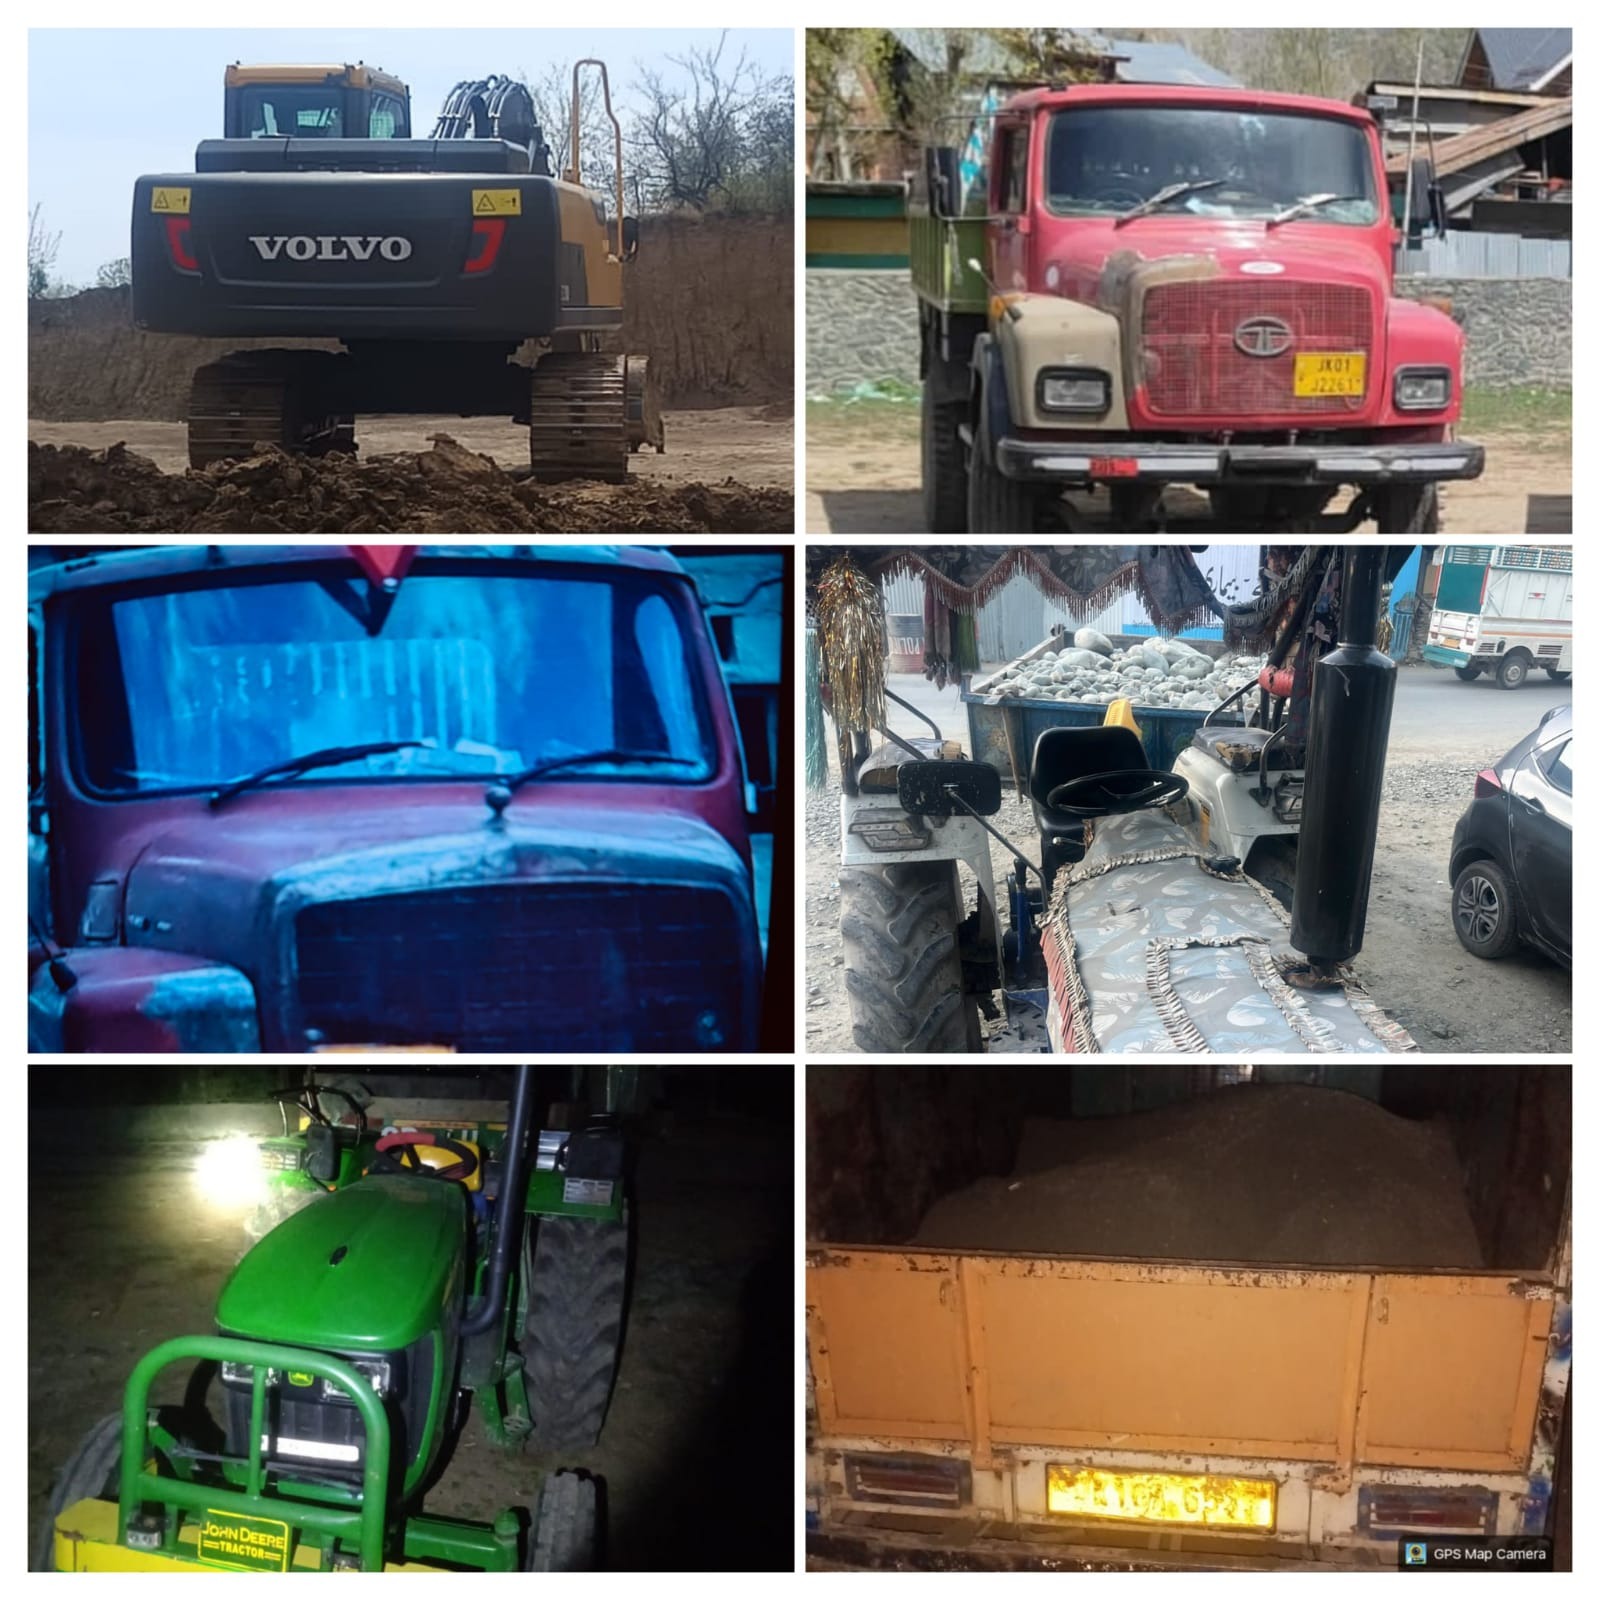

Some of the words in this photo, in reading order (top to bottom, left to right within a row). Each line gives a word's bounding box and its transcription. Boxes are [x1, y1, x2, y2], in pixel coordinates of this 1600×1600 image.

[250, 236, 412, 260] VOLVO
[1317, 358, 1350, 372] JK01
[202, 1521, 238, 1540] JOHN
[240, 1527, 285, 1549] DEERE
[219, 1541, 265, 1560] TRACTOR
